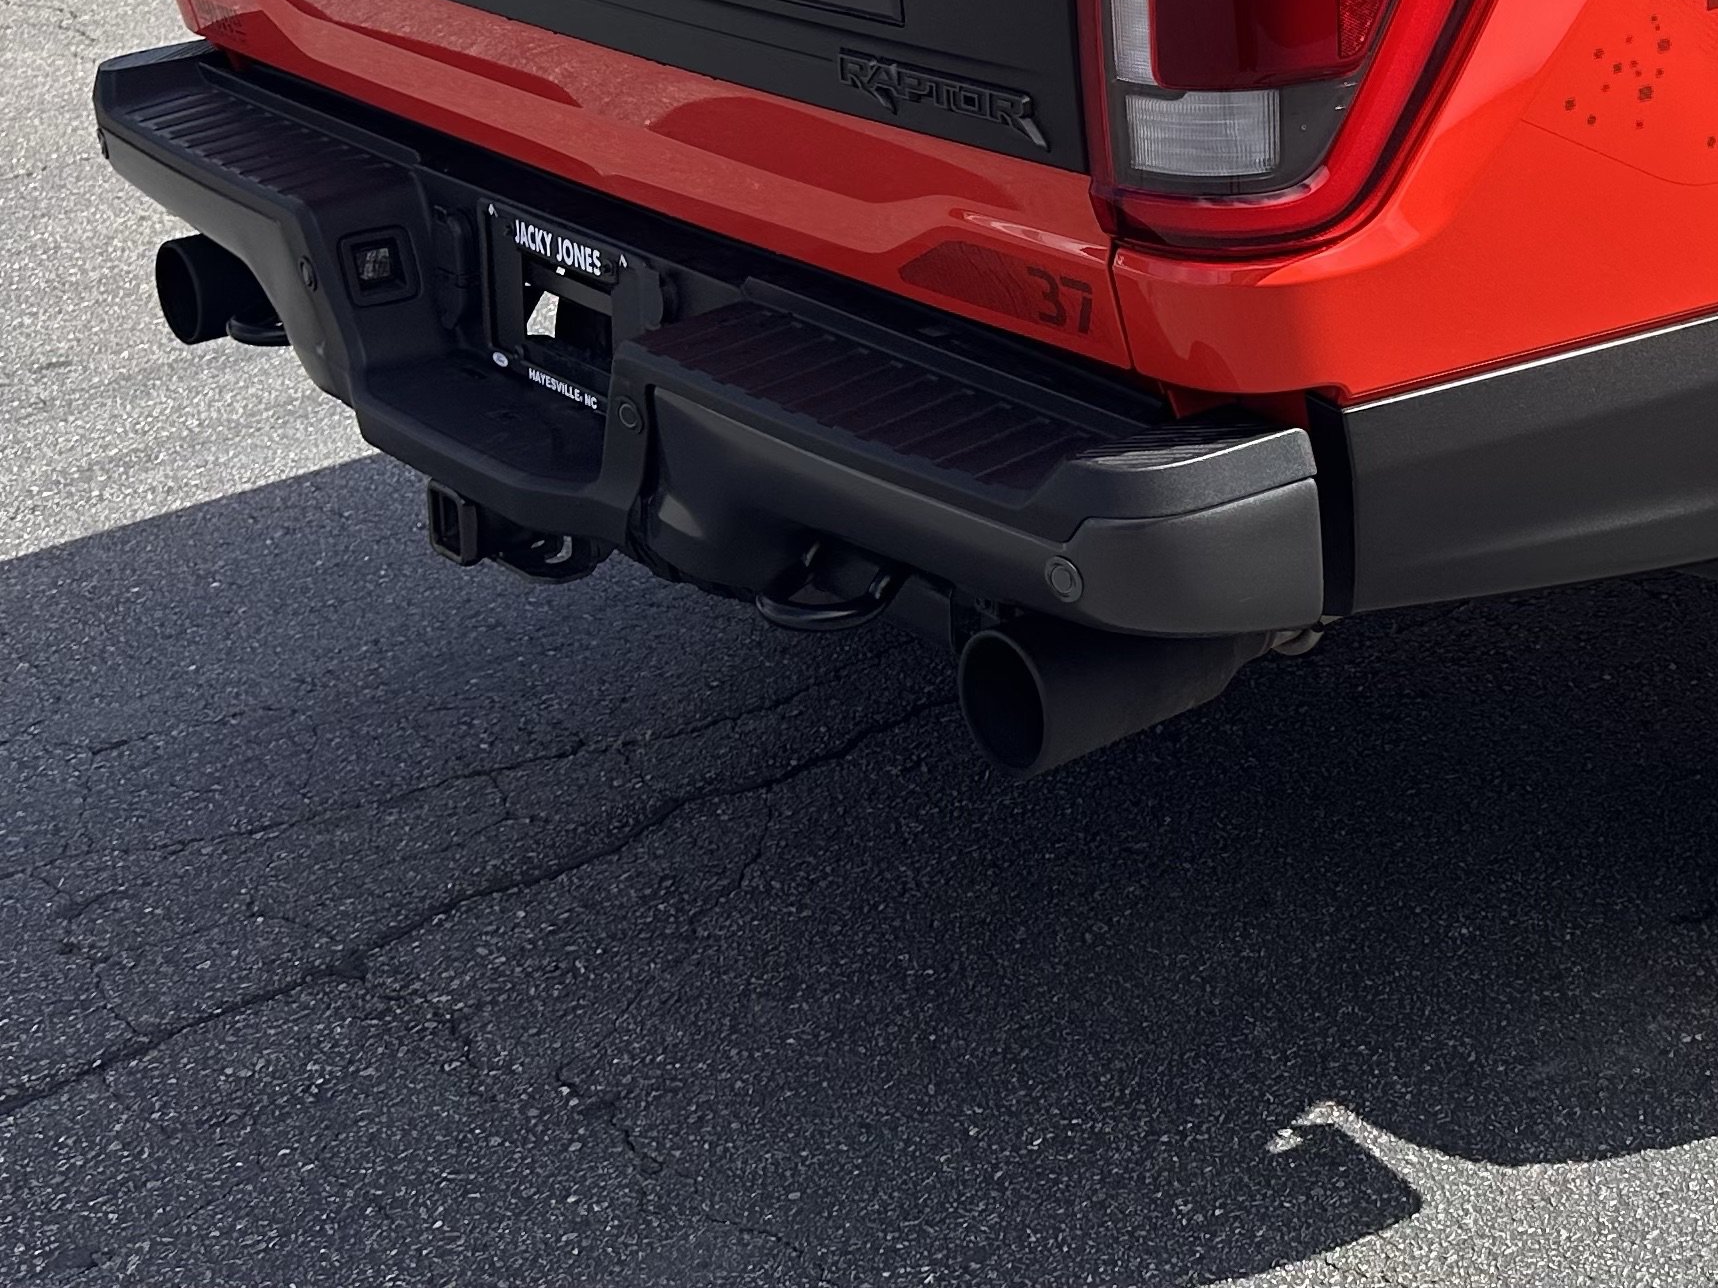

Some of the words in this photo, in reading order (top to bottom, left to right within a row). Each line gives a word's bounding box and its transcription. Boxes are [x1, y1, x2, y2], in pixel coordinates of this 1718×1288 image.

[837, 47, 1051, 153] RAPTOR
[514, 218, 552, 257] JACKY
[556, 235, 602, 277] JONES
[1027, 265, 1093, 335] 37
[585, 393, 598, 410] NC
